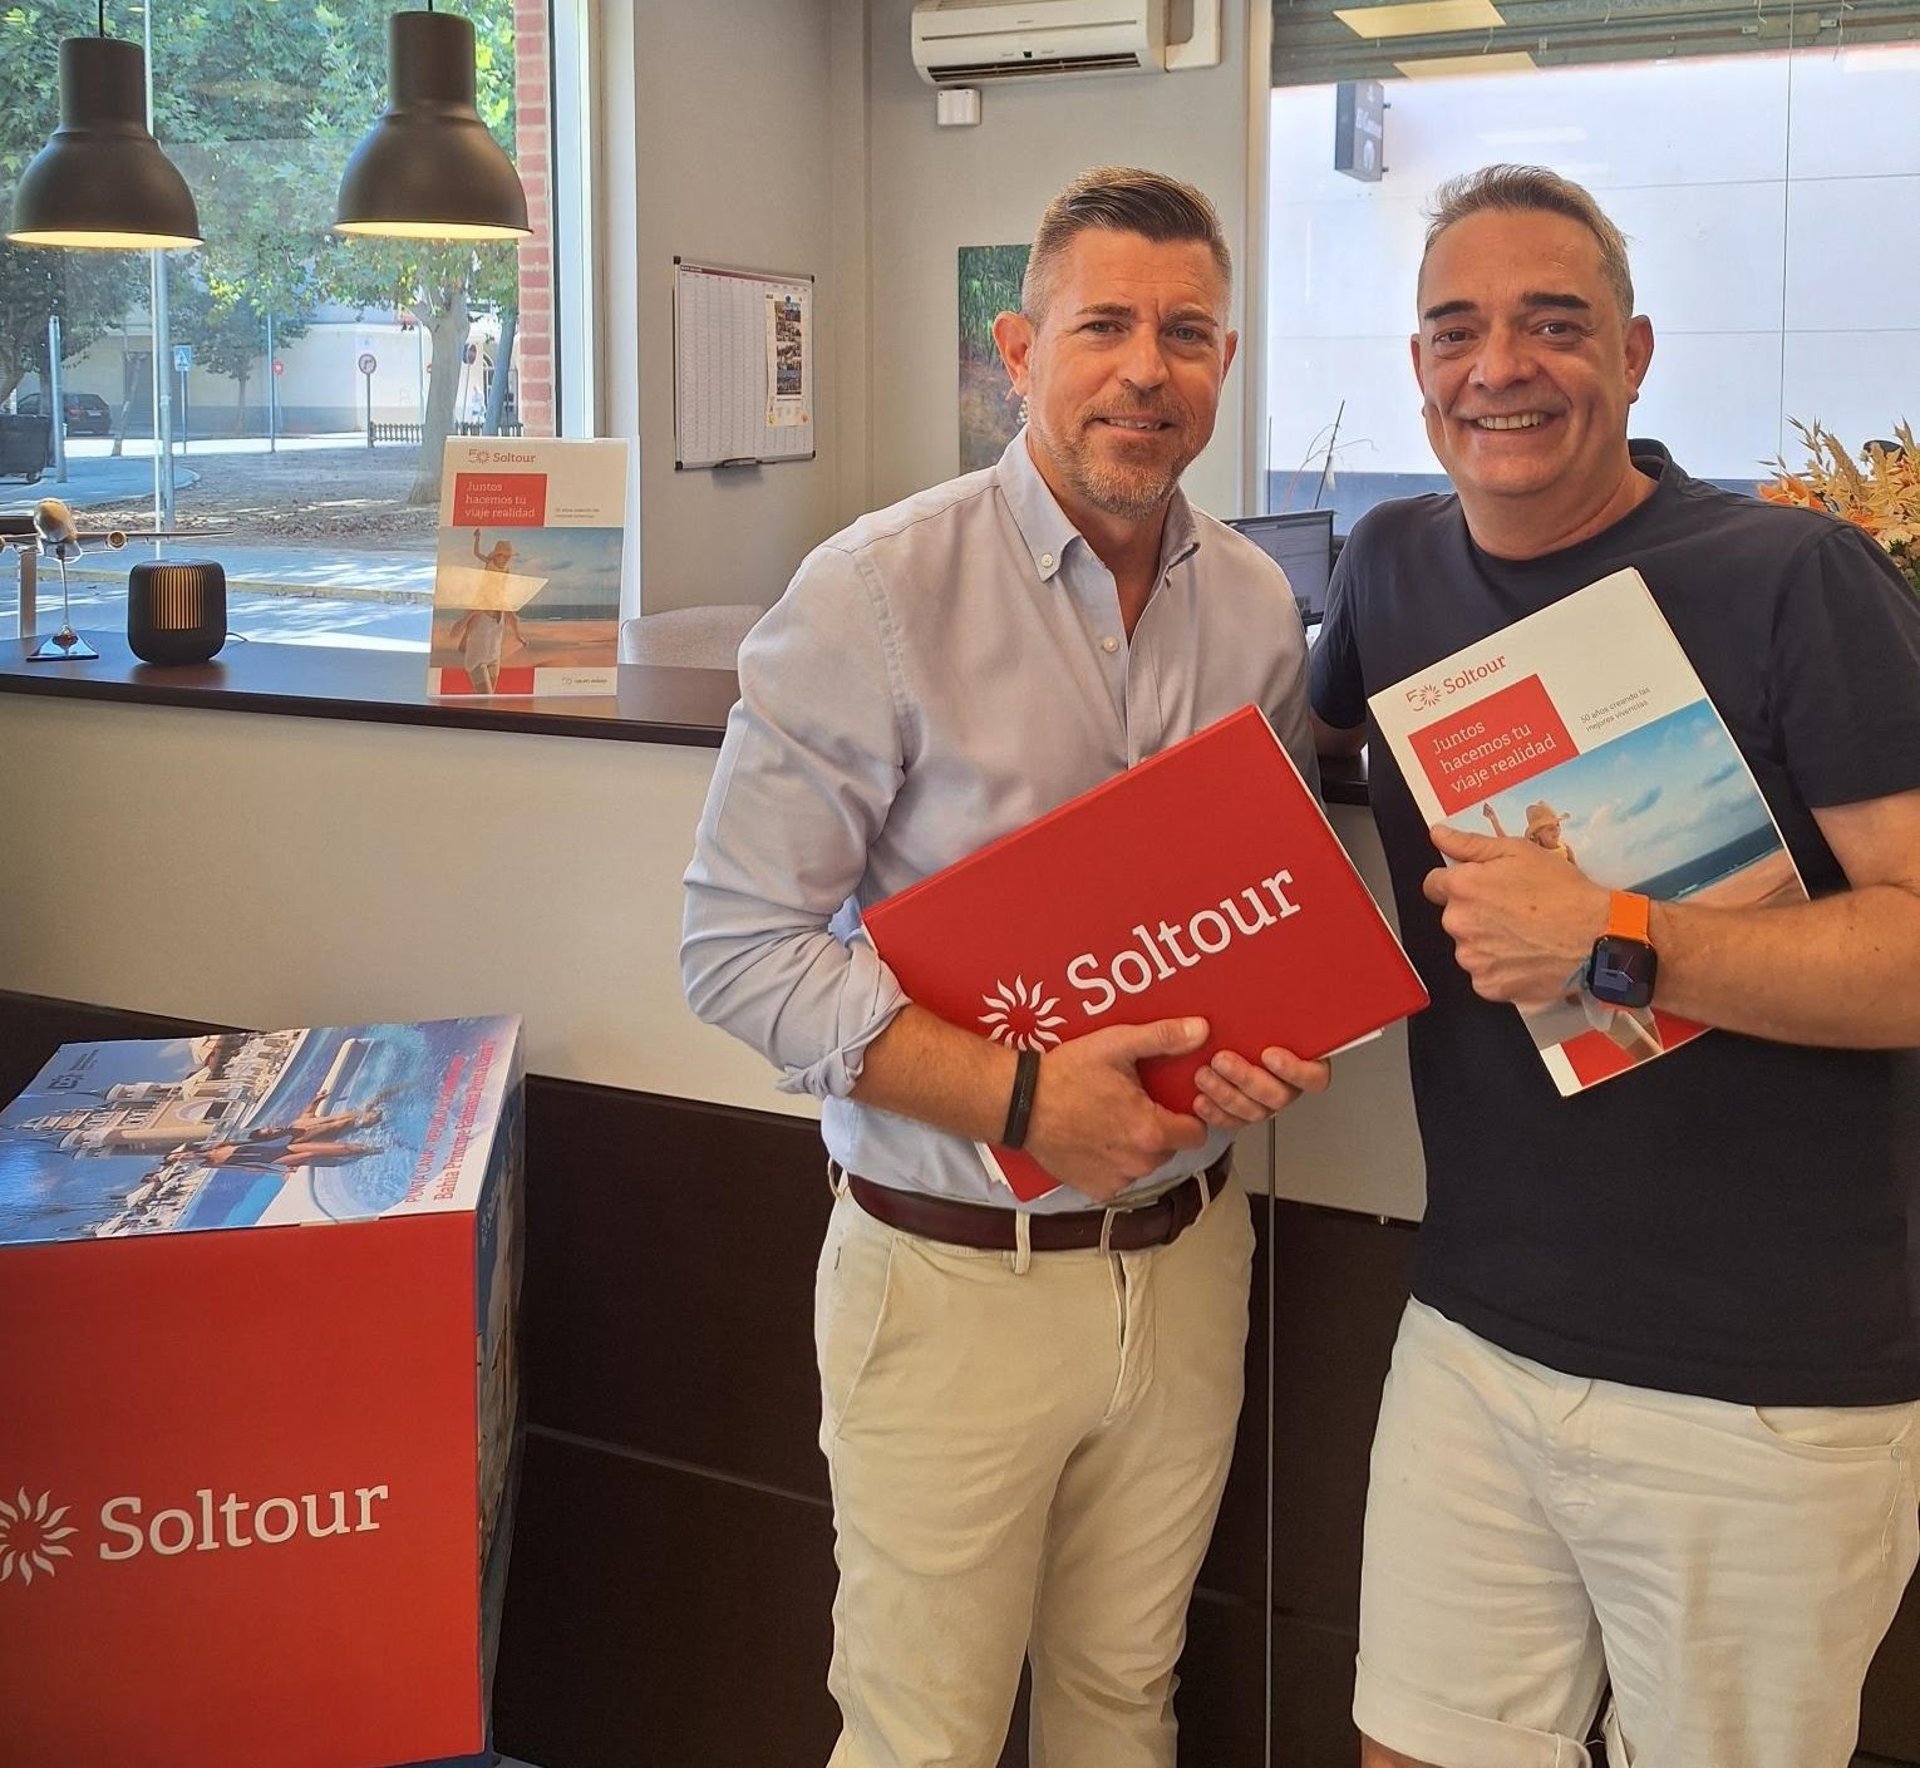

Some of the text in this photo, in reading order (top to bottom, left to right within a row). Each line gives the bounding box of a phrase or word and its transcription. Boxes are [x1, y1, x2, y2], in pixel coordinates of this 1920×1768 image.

[492, 452, 537, 463] Soltour
[465, 494, 527, 505] hacemos tu
[466, 481, 503, 492] Juntos
[464, 507, 535, 519] viaje realidad
[1443, 655, 1507, 695] Soltour
[1580, 687, 1651, 724] 50 años creando las
[1586, 700, 1649, 732] mejores vivencias
[1432, 721, 1486, 755] Juntos
[1440, 723, 1532, 774] hacemos tu
[1451, 733, 1557, 793] viaje realidad
[1066, 869, 1301, 1016] Soltour
[99, 1484, 389, 1561] Soltour
